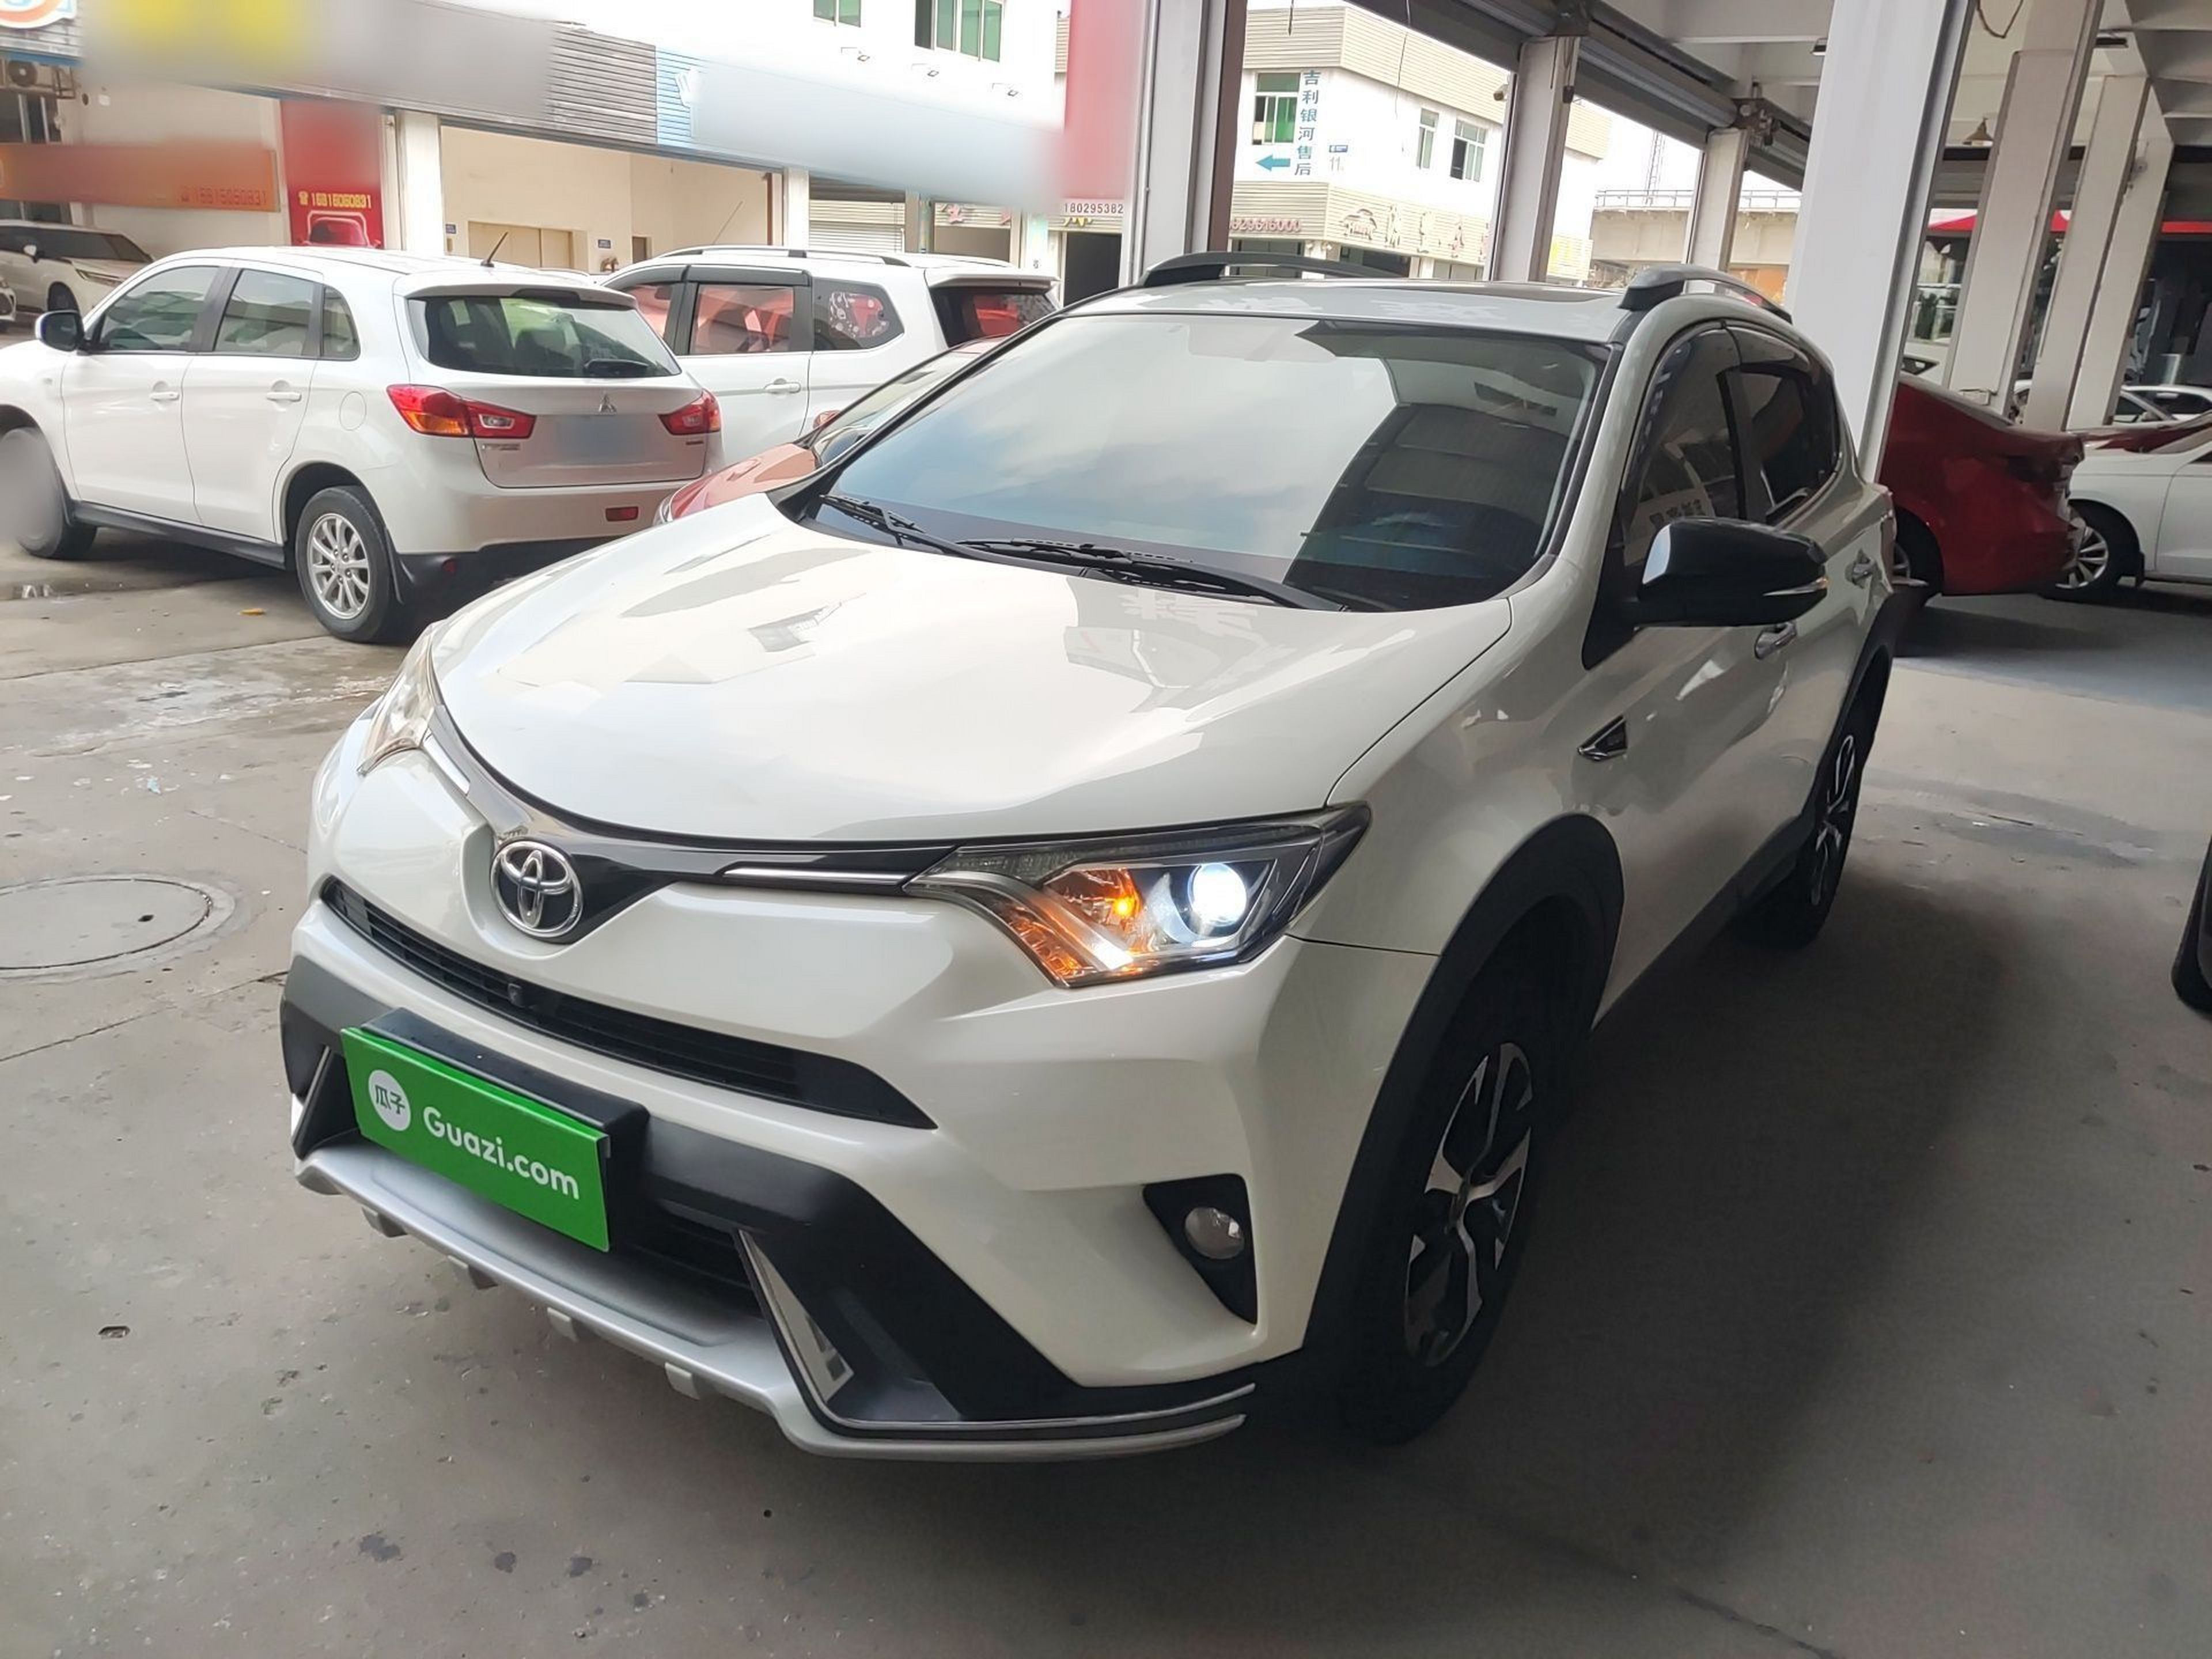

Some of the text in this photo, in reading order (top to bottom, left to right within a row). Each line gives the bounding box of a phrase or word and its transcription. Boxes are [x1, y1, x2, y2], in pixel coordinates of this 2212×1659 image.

[1294, 69, 1321, 176] 吉利银河售后
[374, 1084, 406, 1115] 瓜子
[423, 1106, 579, 1200] Guazi.com
